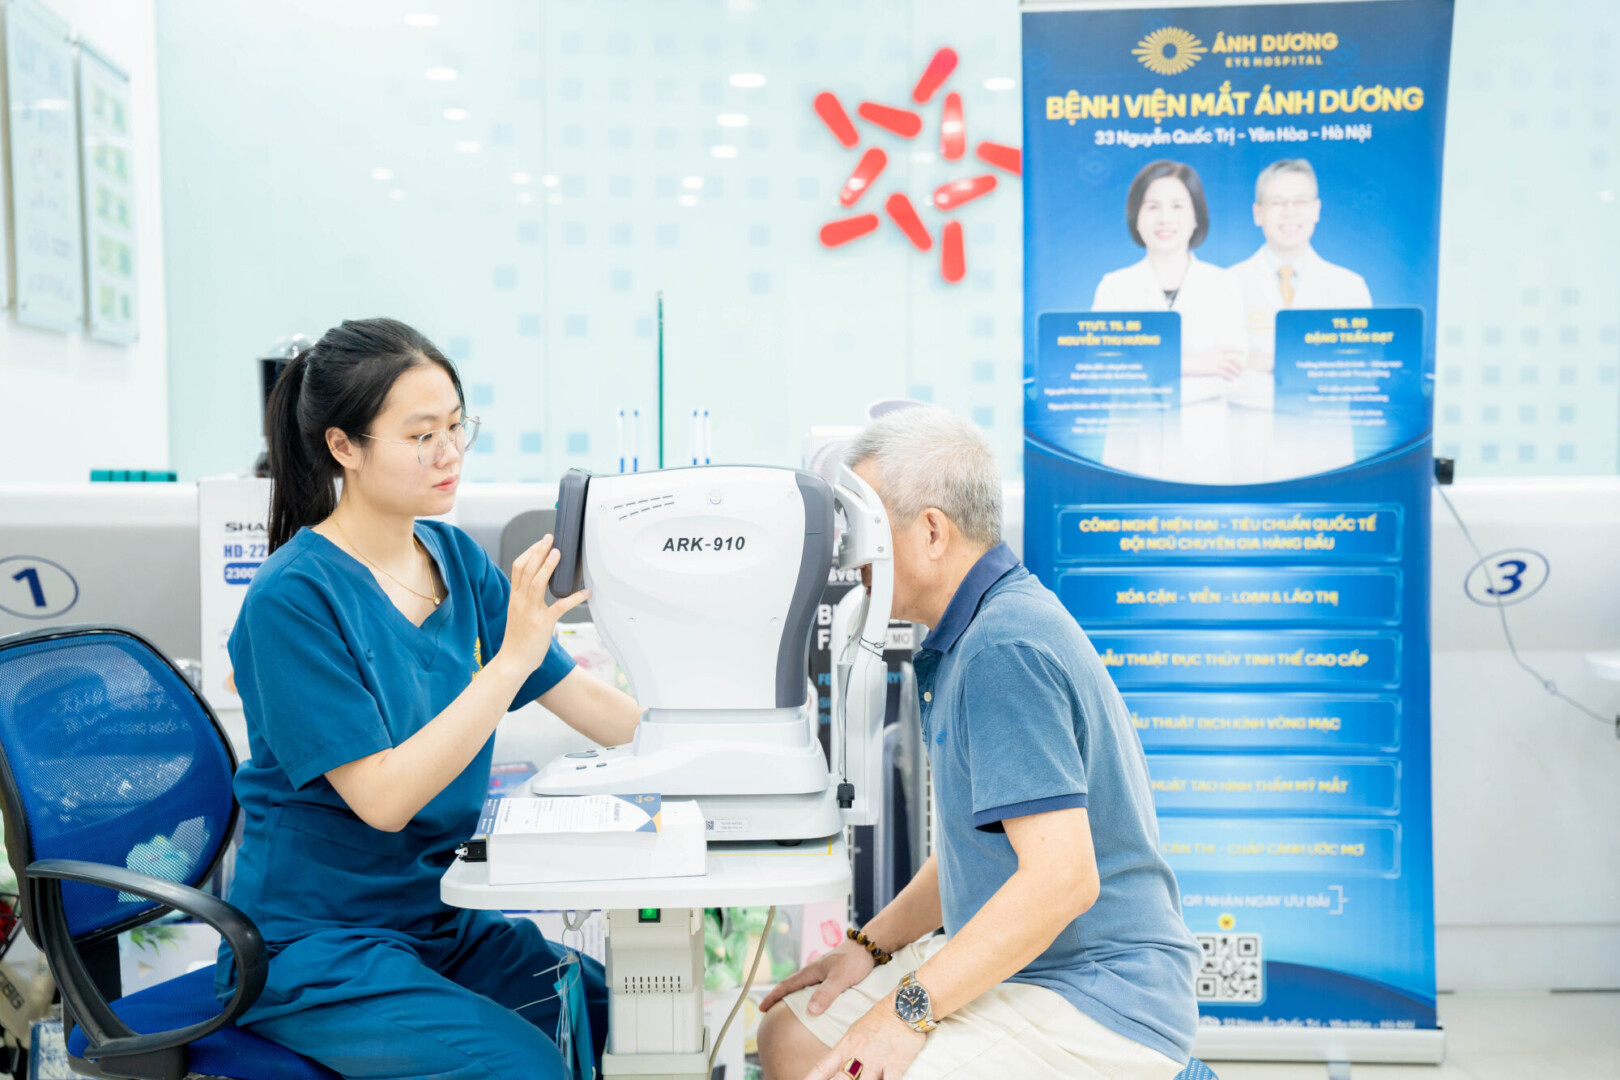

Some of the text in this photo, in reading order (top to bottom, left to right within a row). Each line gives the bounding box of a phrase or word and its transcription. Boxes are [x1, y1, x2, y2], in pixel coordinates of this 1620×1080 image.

[1212, 31, 1339, 53] ÁNH DƯƠNG
[1225, 55, 1323, 68] EYE HOSPITAL
[1046, 80, 1425, 126] BỆNH VIỆN MẮT ÁNH DƯƠNG
[1094, 130, 1115, 146] 33
[1116, 126, 1172, 148] Nguyễn
[1172, 126, 1213, 145] Quốc
[1214, 126, 1236, 147] Trị
[1248, 126, 1275, 142] Yên
[1321, 123, 1344, 140] Hà
[1345, 123, 1372, 143] Nội
[225, 523, 268, 533] SHA
[1079, 515, 1120, 533] CÔNG
[1312, 513, 1356, 531] QUỐC
[224, 544, 268, 558] HD-22
[662, 536, 746, 552] ARK-910
[1178, 535, 1236, 551] CHUYÊN
[1236, 537, 1260, 550] GIA
[225, 566, 257, 580] 2300
[1486, 560, 1527, 596] 3
[12, 567, 47, 608] 1
[1100, 648, 1125, 667] ẪU
[1304, 653, 1337, 667] CAO
[1338, 649, 1369, 667] CẤP
